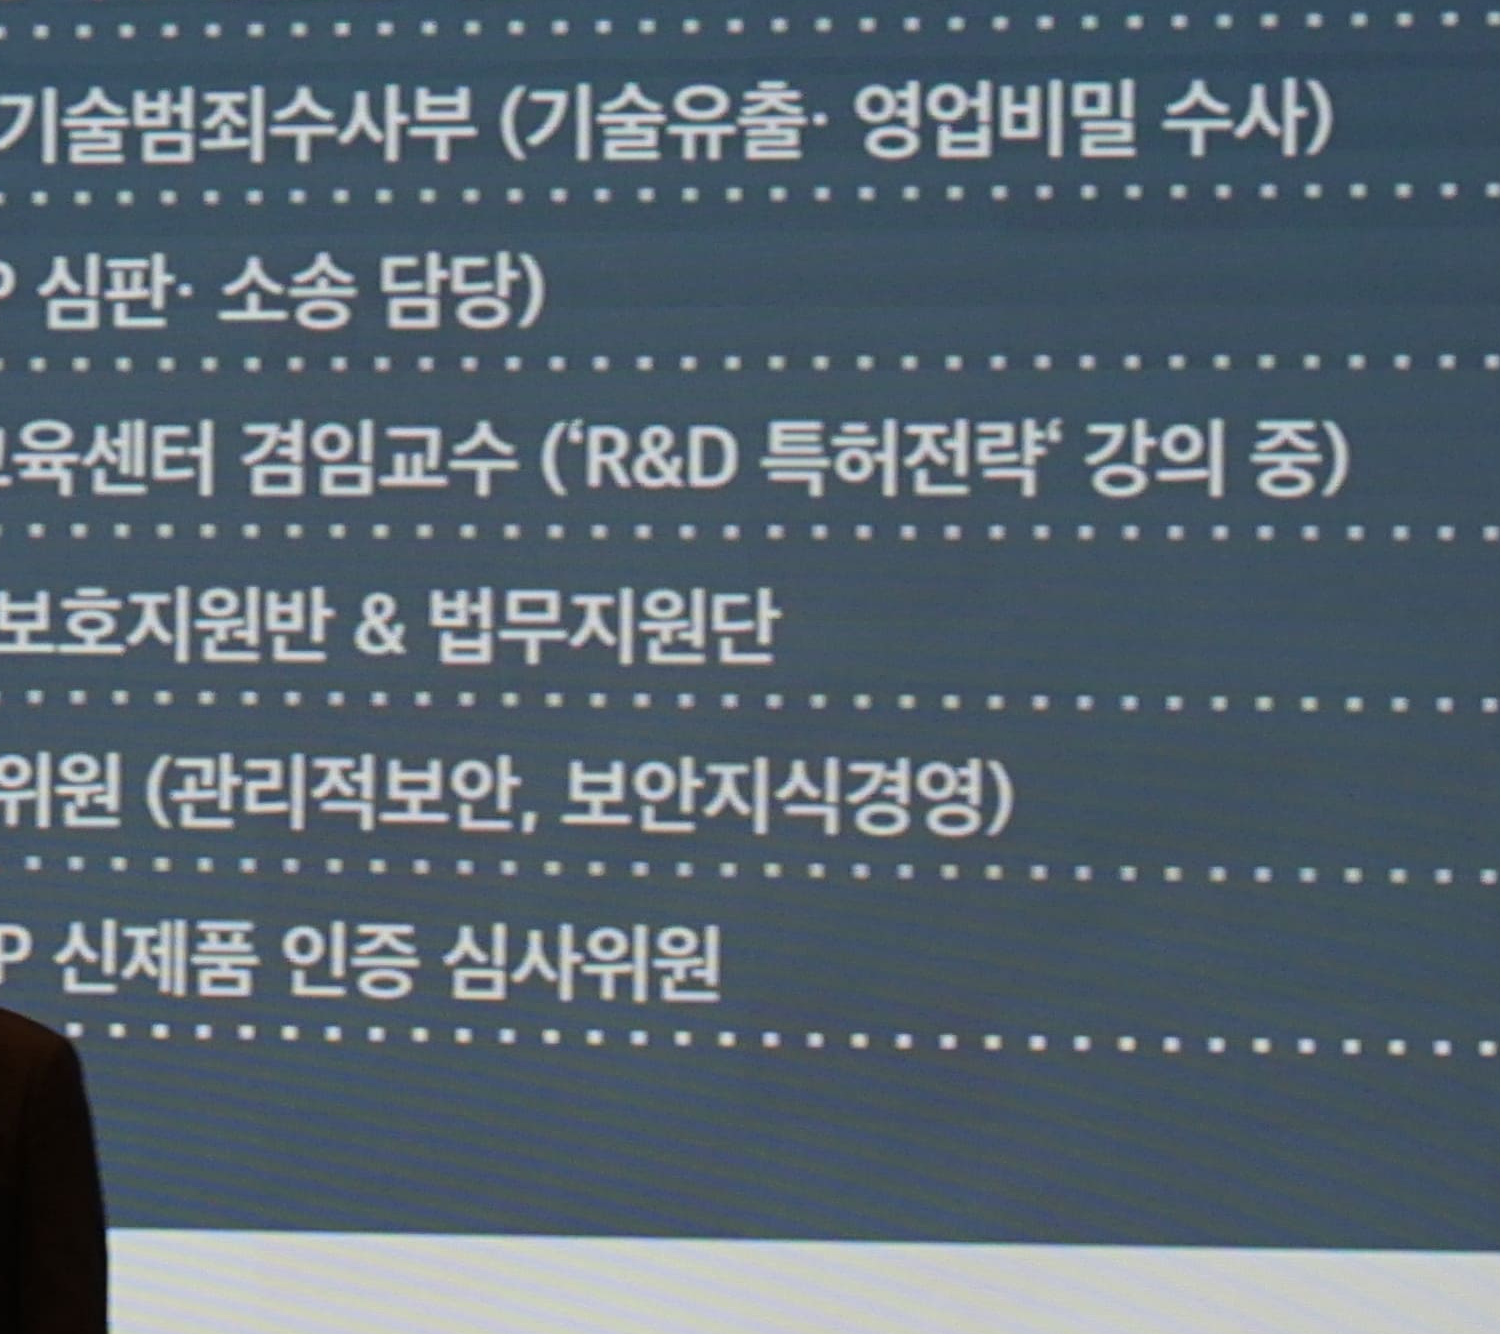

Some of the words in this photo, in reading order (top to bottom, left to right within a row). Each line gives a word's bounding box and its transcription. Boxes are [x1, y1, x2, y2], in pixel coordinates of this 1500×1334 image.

[854, 77, 1137, 160] 영업비밀
[1161, 76, 1333, 158] 수사)
[217, 251, 359, 331] 소송
[380, 249, 545, 330] 담당)
[240, 417, 520, 498] 겸임교수
[1083, 417, 1225, 499] 강의
[1249, 419, 1349, 499] 중)
[353, 591, 407, 656] &
[428, 585, 784, 667] 법무지원단
[145, 751, 538, 835] (관리적보안,
[560, 755, 1014, 838] 보안지식경영)
[52, 917, 261, 998] 신제품
[281, 919, 422, 1001] 인증
[441, 921, 721, 1004] 심사위원
